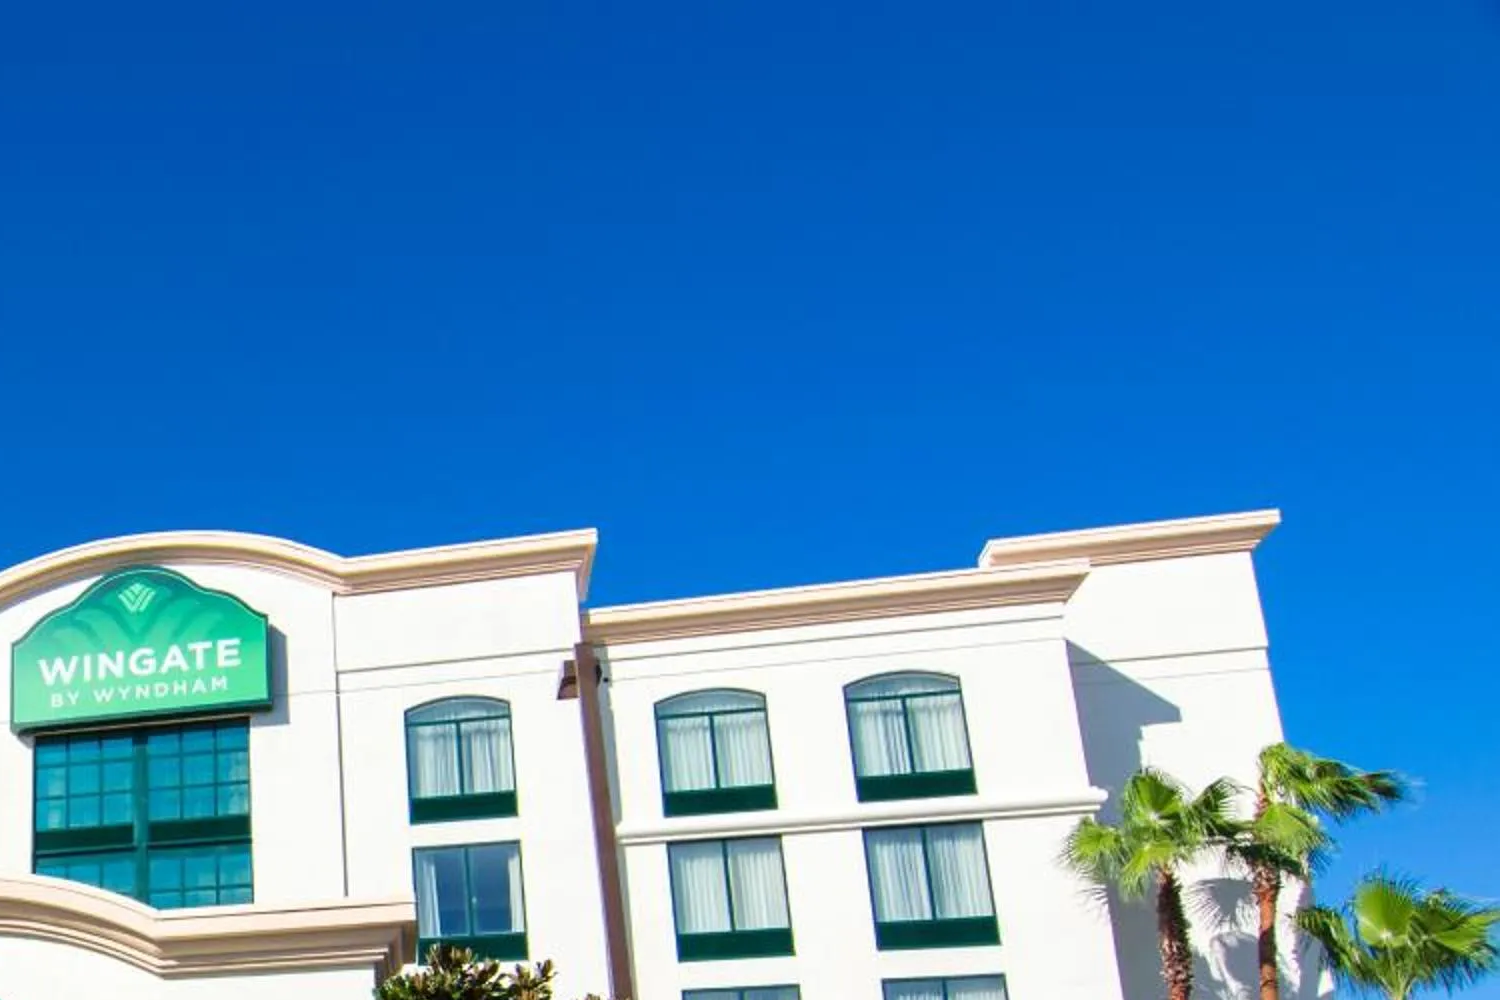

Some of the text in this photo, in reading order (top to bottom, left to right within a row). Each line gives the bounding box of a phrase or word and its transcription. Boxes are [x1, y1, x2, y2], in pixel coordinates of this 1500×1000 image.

[38, 638, 242, 686] WINGATE
[51, 675, 229, 708] BY WYNDHAM
